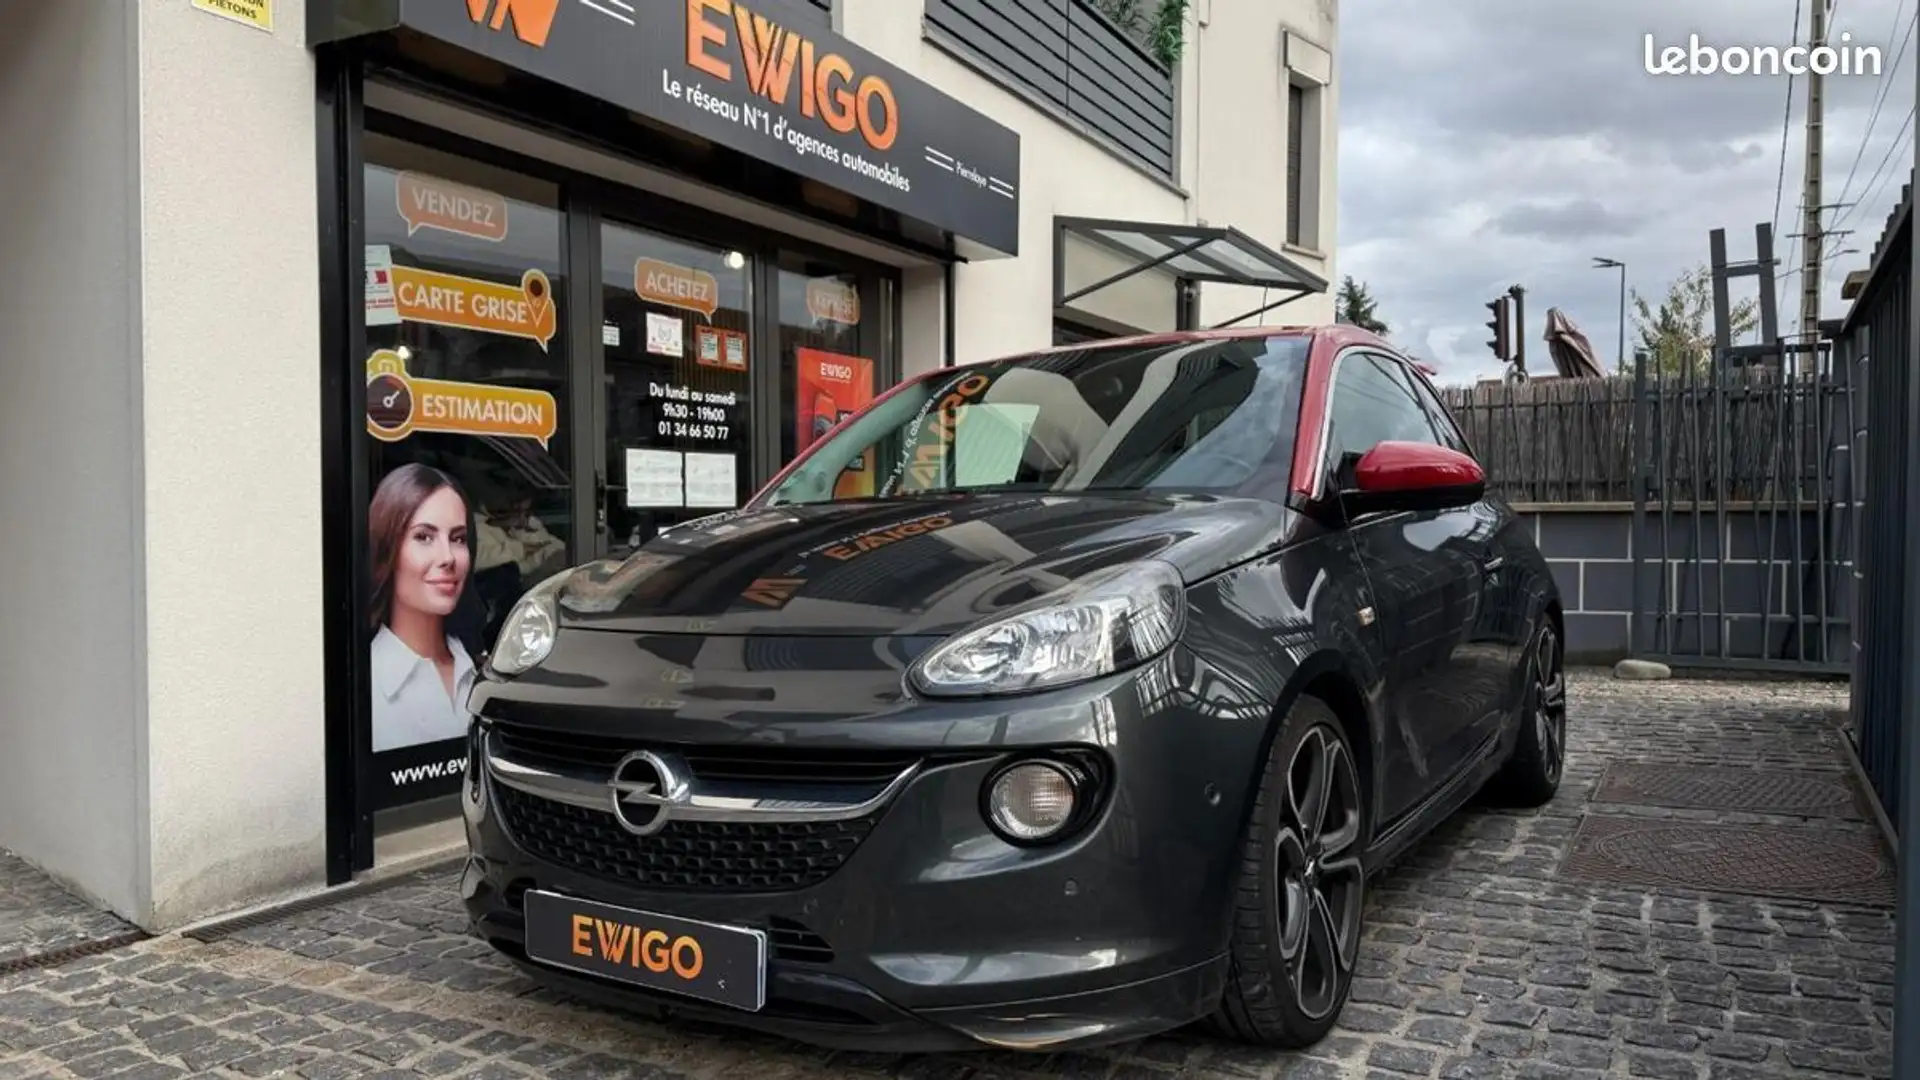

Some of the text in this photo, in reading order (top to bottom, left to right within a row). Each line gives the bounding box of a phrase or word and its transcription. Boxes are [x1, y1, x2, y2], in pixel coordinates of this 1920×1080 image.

[686, 0, 898, 151] EWIGO
[662, 68, 911, 192] Le réseau N°1 d'agences automobiles
[412, 186, 497, 228] VENDEZ
[398, 282, 465, 314] CARTE
[471, 294, 528, 324] GRISE
[645, 271, 708, 300] ACHETEZ
[422, 393, 543, 426] ESTIMATION
[649, 382, 736, 405] Du lundi au samedi
[658, 421, 729, 440] 01 34 66 50 77
[662, 403, 688, 418] 9h30
[696, 407, 726, 422] 19h00
[571, 913, 704, 980] EWIGO
